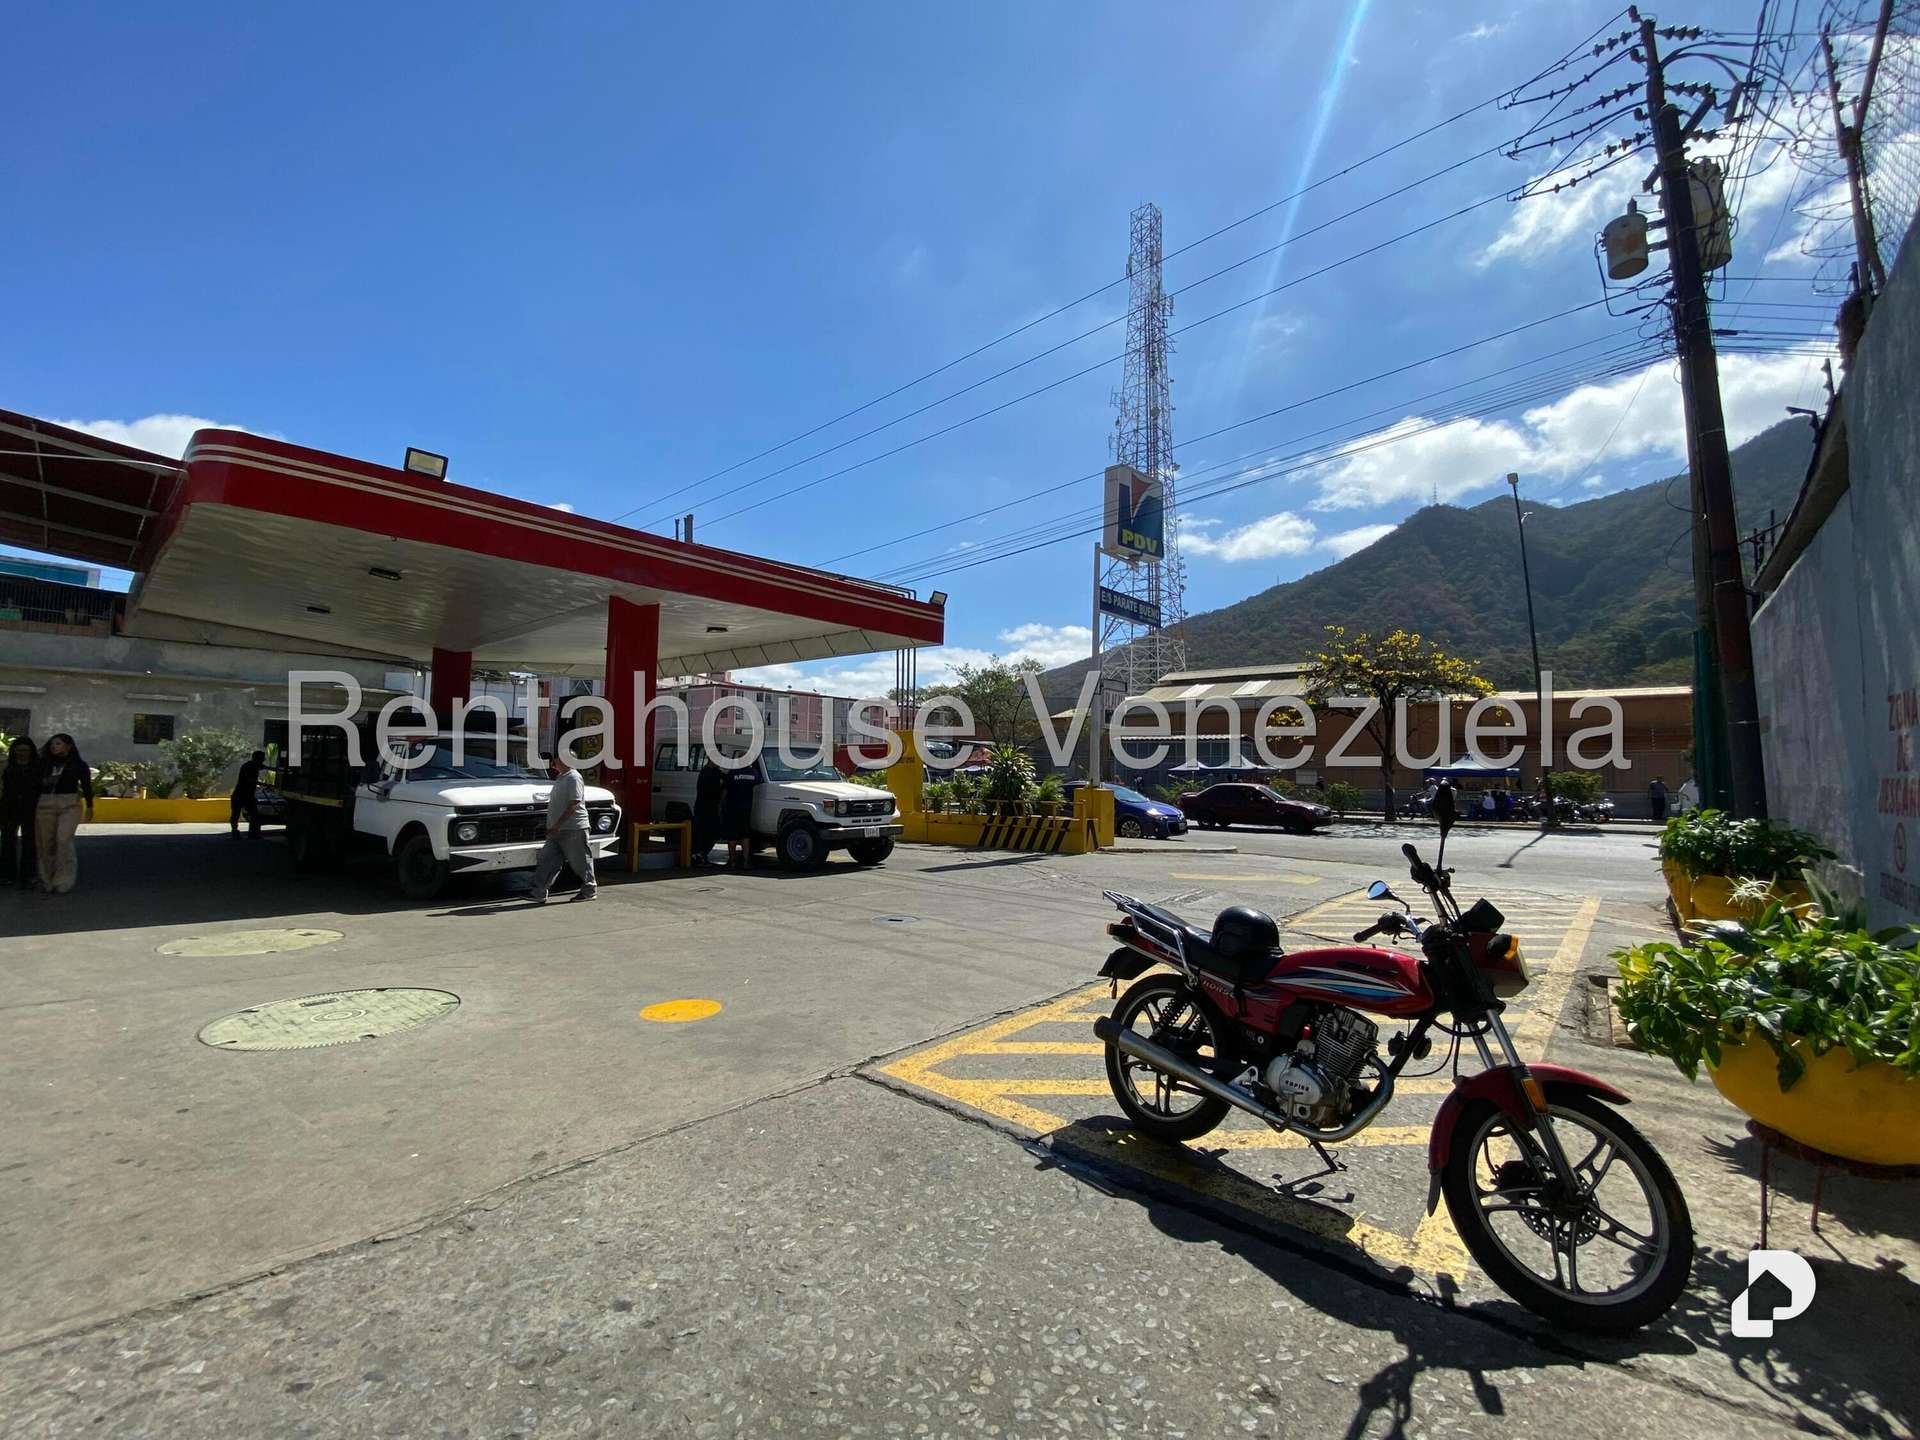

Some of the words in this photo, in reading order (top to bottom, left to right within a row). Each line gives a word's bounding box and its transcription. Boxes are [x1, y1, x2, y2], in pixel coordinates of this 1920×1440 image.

[1122, 528, 1157, 553] PDV
[1113, 595, 1138, 613] PARATE
[1887, 688, 1919, 730] ZONA
